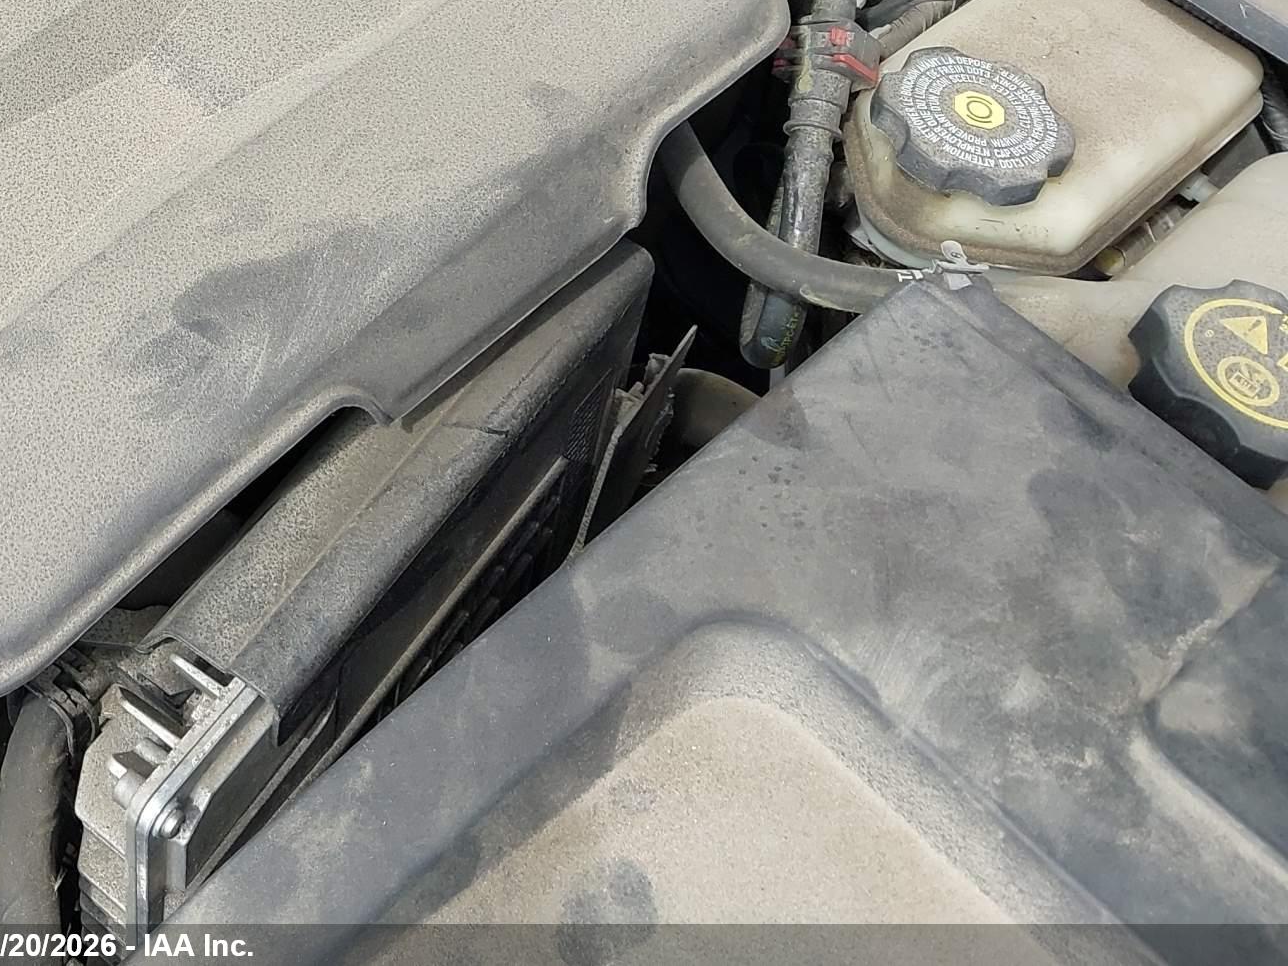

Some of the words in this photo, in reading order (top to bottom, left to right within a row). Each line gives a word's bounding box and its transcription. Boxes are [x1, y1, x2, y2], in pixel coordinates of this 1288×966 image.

[914, 57, 942, 72] AVANT
[939, 56, 955, 64] LA
[926, 69, 941, 79] DE
[936, 64, 964, 75] FREIN
[900, 67, 922, 96] BOUCHON
[900, 95, 913, 105] LE
[990, 82, 1021, 104] FILLER
[1013, 88, 1034, 103] USE
[914, 99, 927, 109] DU
[918, 110, 938, 126] QUE
[1013, 104, 1030, 128] CLEAN
[1038, 104, 1058, 131] SEALED
[903, 106, 941, 143] NETTOYER
[933, 113, 987, 146] PROVENANT
[1009, 136, 1039, 156] BEFORE
[1038, 133, 1058, 154] FROM
[993, 148, 1013, 157] CAP
[1019, 149, 1046, 165] FLUID
[997, 157, 1024, 168] DOT3
